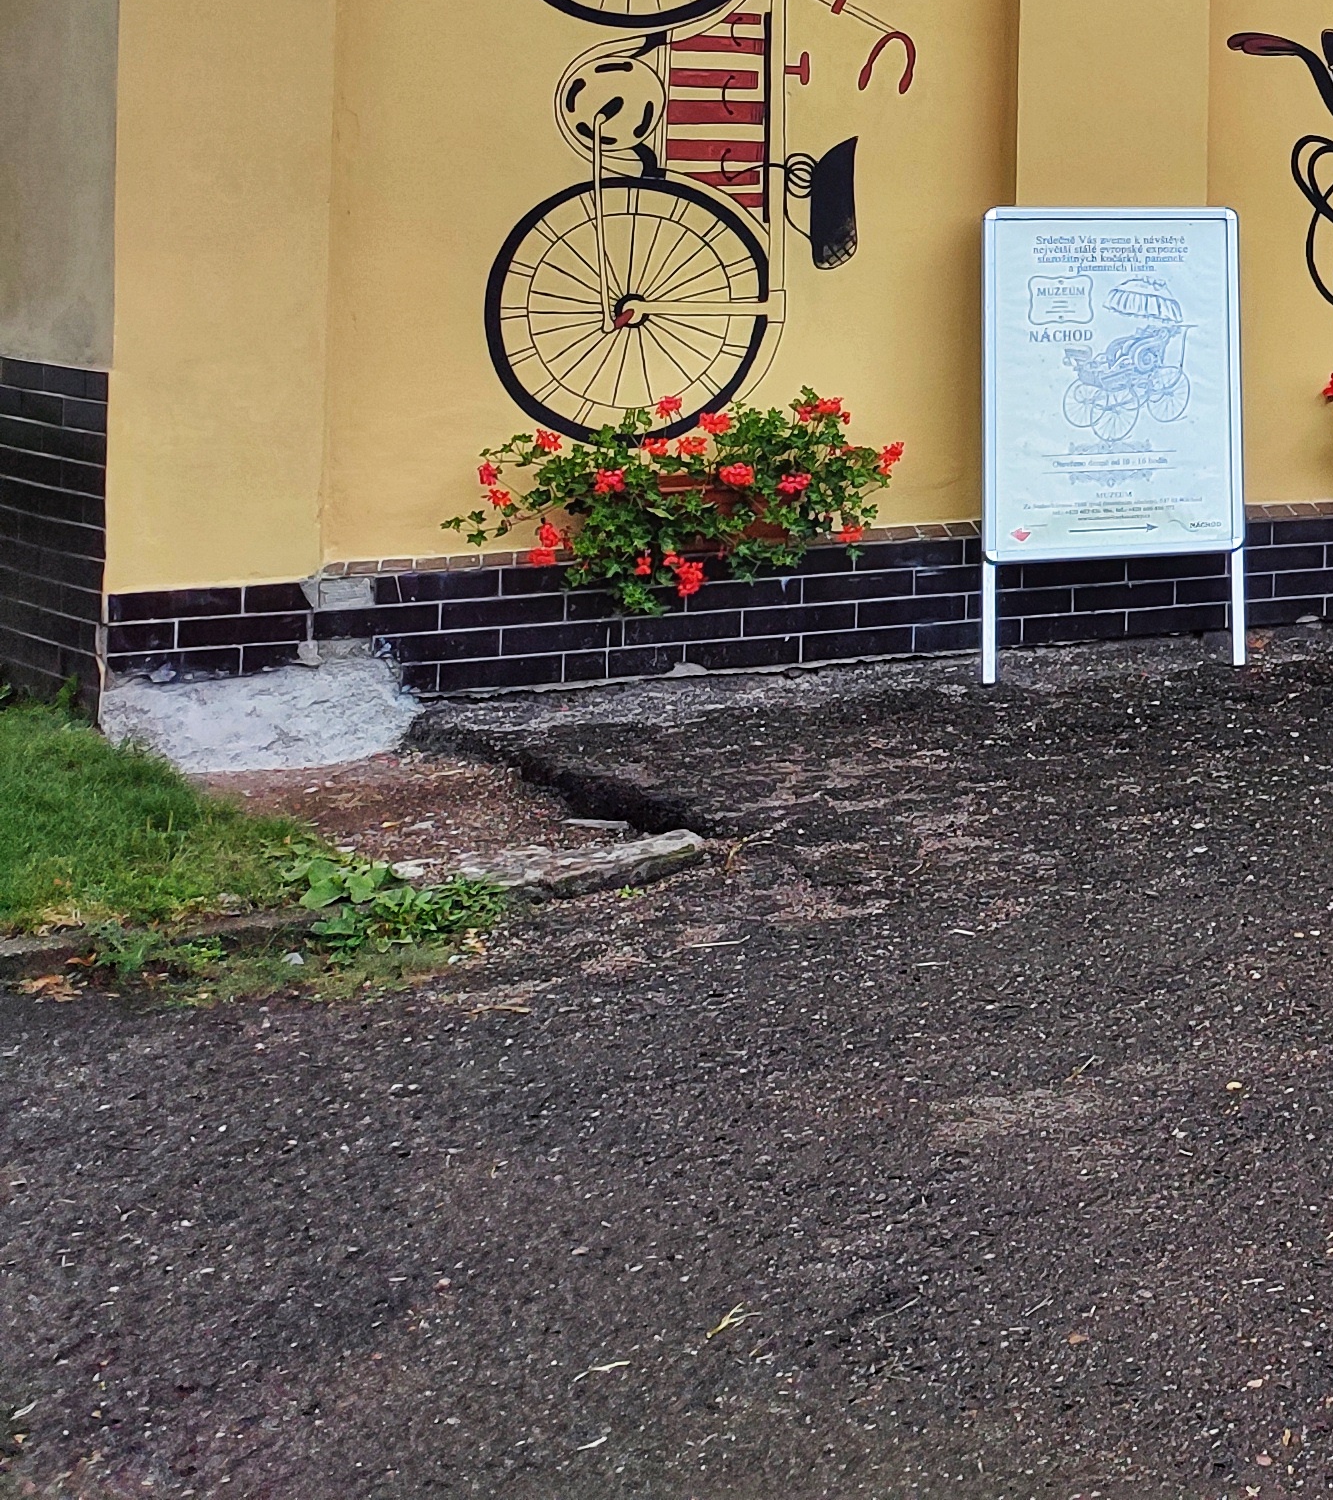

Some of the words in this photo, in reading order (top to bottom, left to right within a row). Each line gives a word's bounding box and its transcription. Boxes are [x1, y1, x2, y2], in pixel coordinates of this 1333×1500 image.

[1078, 235, 1098, 245] Vás
[1036, 286, 1086, 297] MUZEUM
[1029, 327, 1094, 342] NÁCHOD
